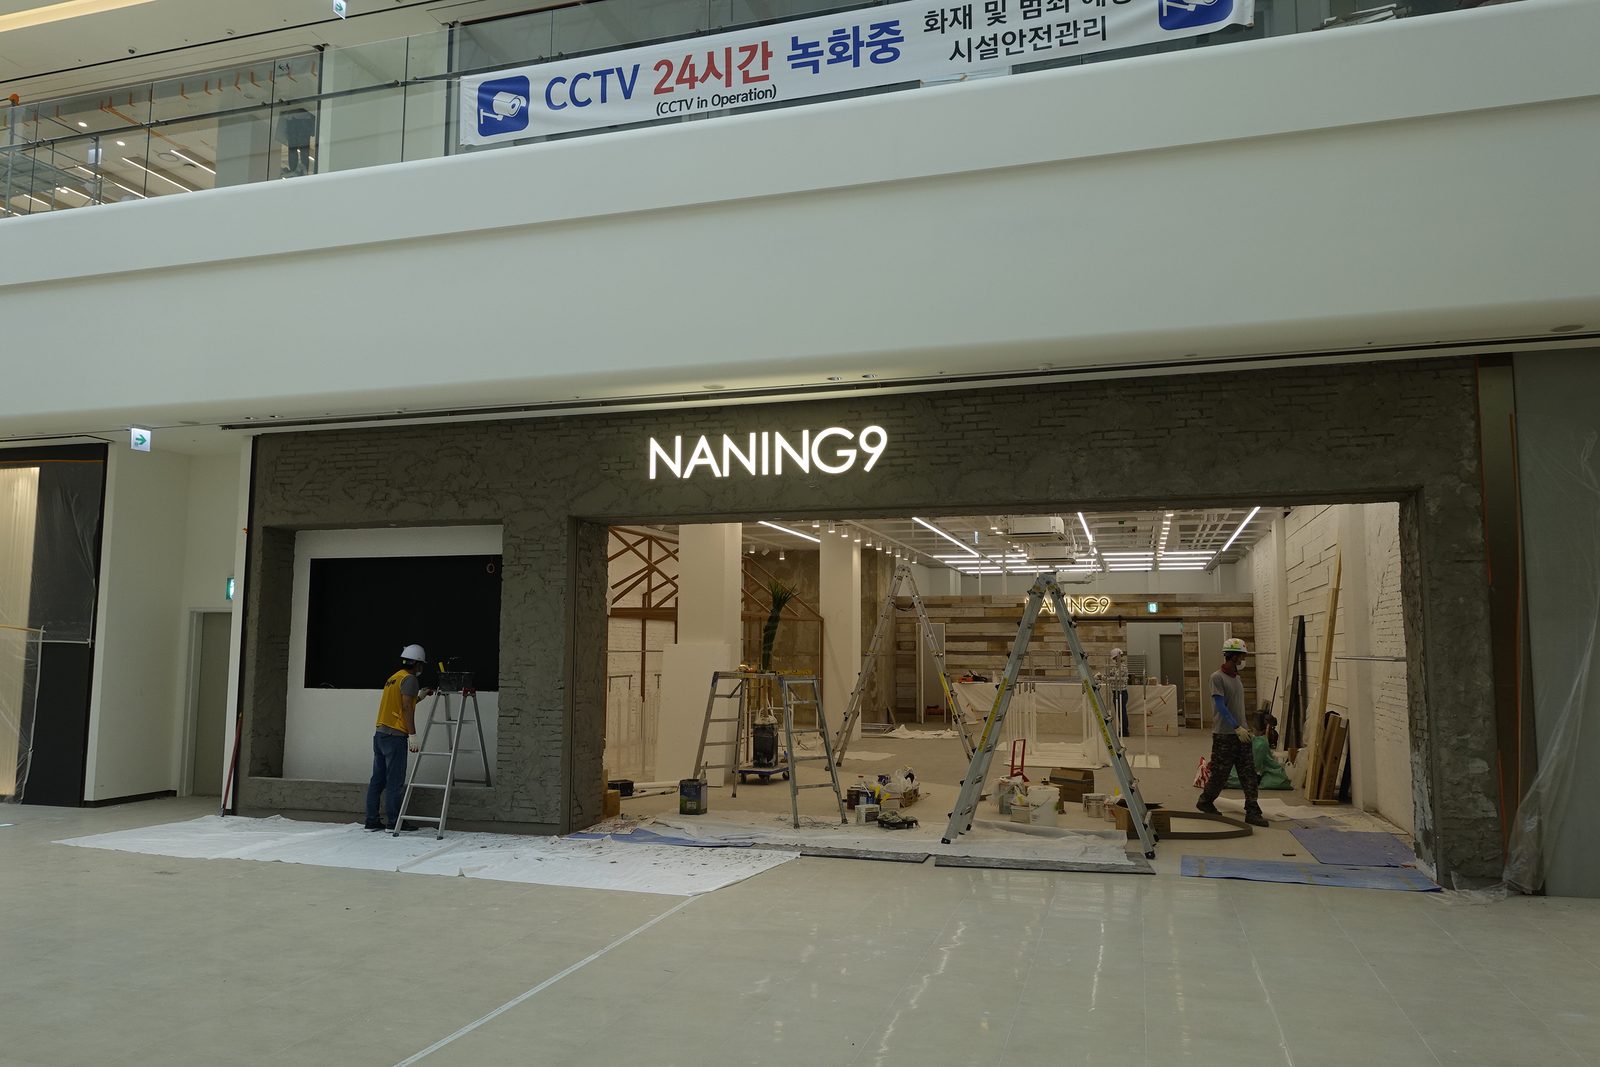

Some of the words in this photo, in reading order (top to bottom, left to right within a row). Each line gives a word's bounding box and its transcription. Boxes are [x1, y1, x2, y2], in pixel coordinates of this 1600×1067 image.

[923, 4, 973, 34] 화재
[984, 1, 1007, 26] 및
[948, 15, 1107, 63] 시설안전관리
[545, 64, 640, 111] CCTV
[653, 40, 773, 95] 24시간
[787, 20, 905, 74] 녹화중
[656, 97, 694, 117] (CCTV
[696, 96, 708, 109] in
[711, 84, 777, 107] Operation)
[649, 425, 888, 479] NANING9
[1025, 596, 1111, 614] AING9
